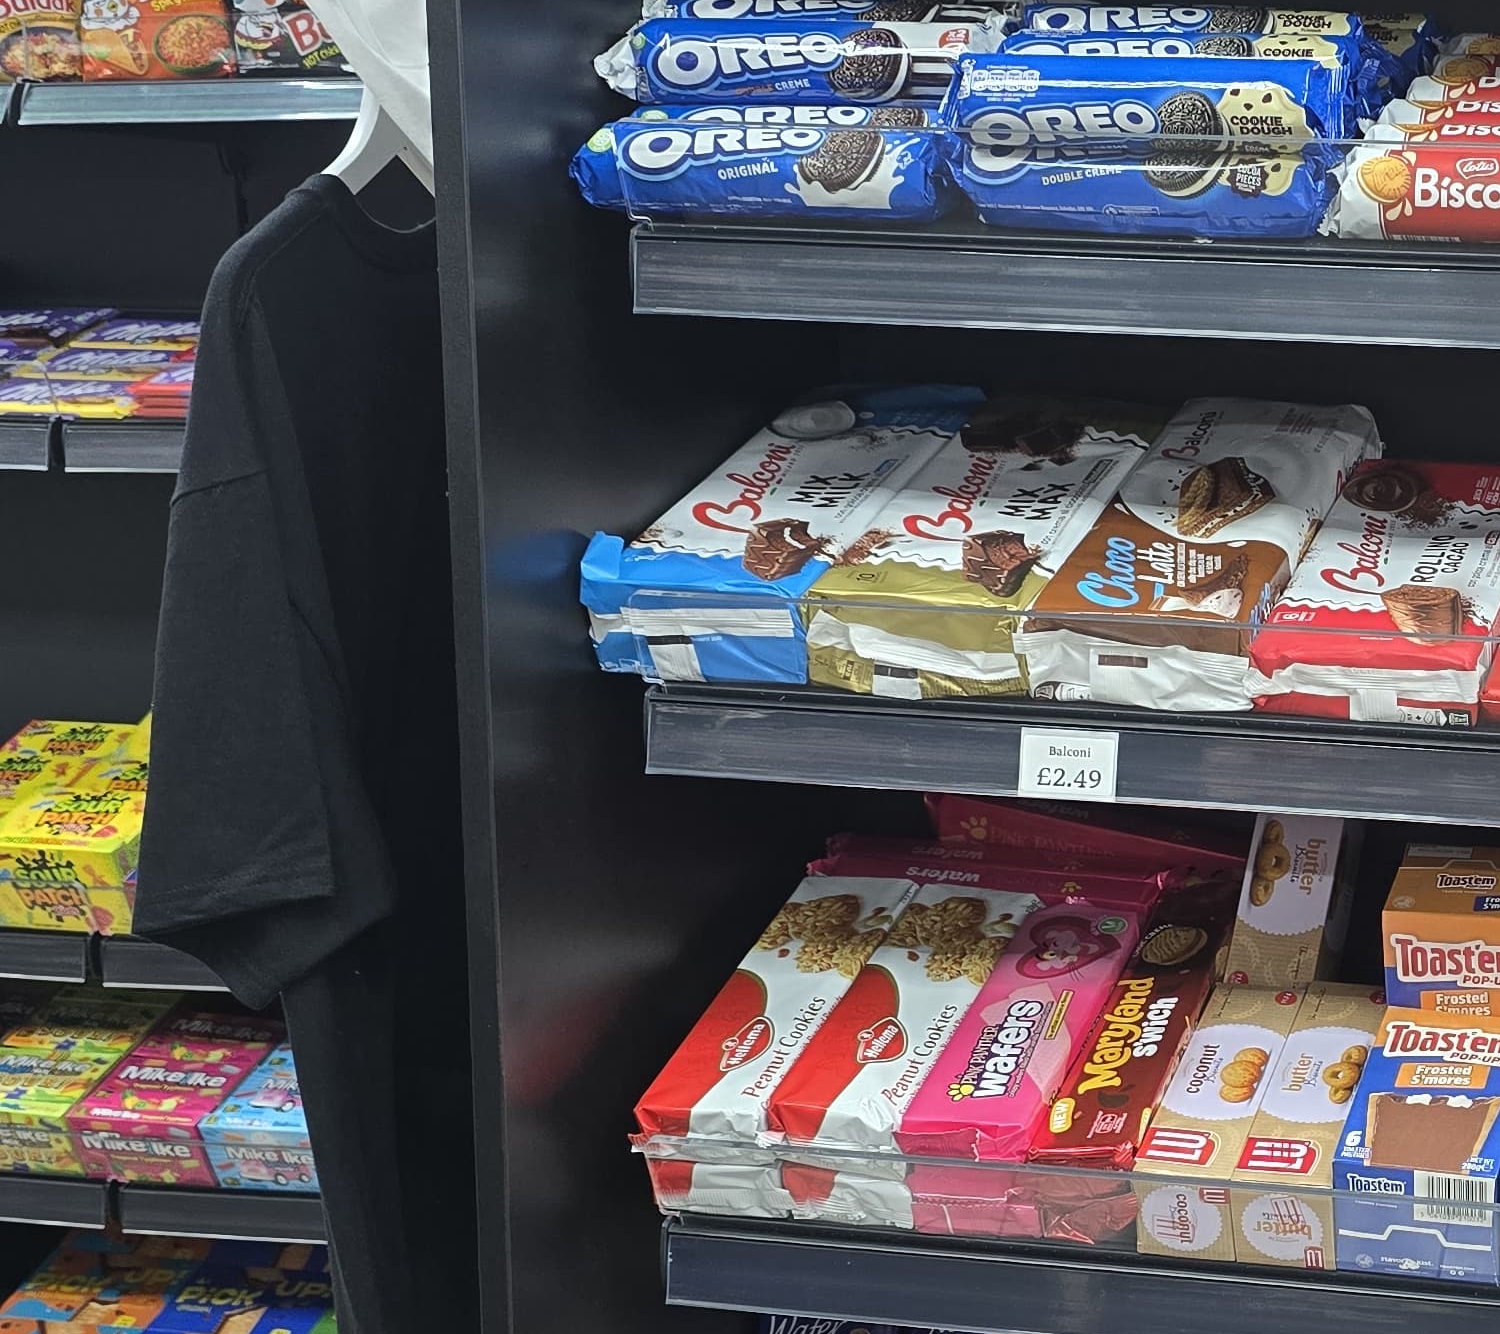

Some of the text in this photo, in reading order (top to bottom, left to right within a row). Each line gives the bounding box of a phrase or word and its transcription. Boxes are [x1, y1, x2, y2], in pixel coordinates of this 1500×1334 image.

[657, 30, 844, 86] OREO
[969, 101, 1158, 161] OREO
[717, 159, 779, 181] ORIGINAL
[1076, 537, 1134, 606] Choco
[1320, 511, 1388, 594] Balconi
[1409, 533, 1457, 583] ROLLINO
[1036, 767, 1101, 789] £2.49
[1049, 745, 1091, 759] Balconi
[970, 999, 1044, 1099] wafers
[1079, 976, 1155, 1094] Maryland
[1134, 995, 1178, 1059] S'wich
[120, 1065, 183, 1083] Mike
[1186, 1042, 1221, 1095] coconut
[1410, 1075, 1471, 1086] S'mores
[1415, 1065, 1473, 1079] Frosted
